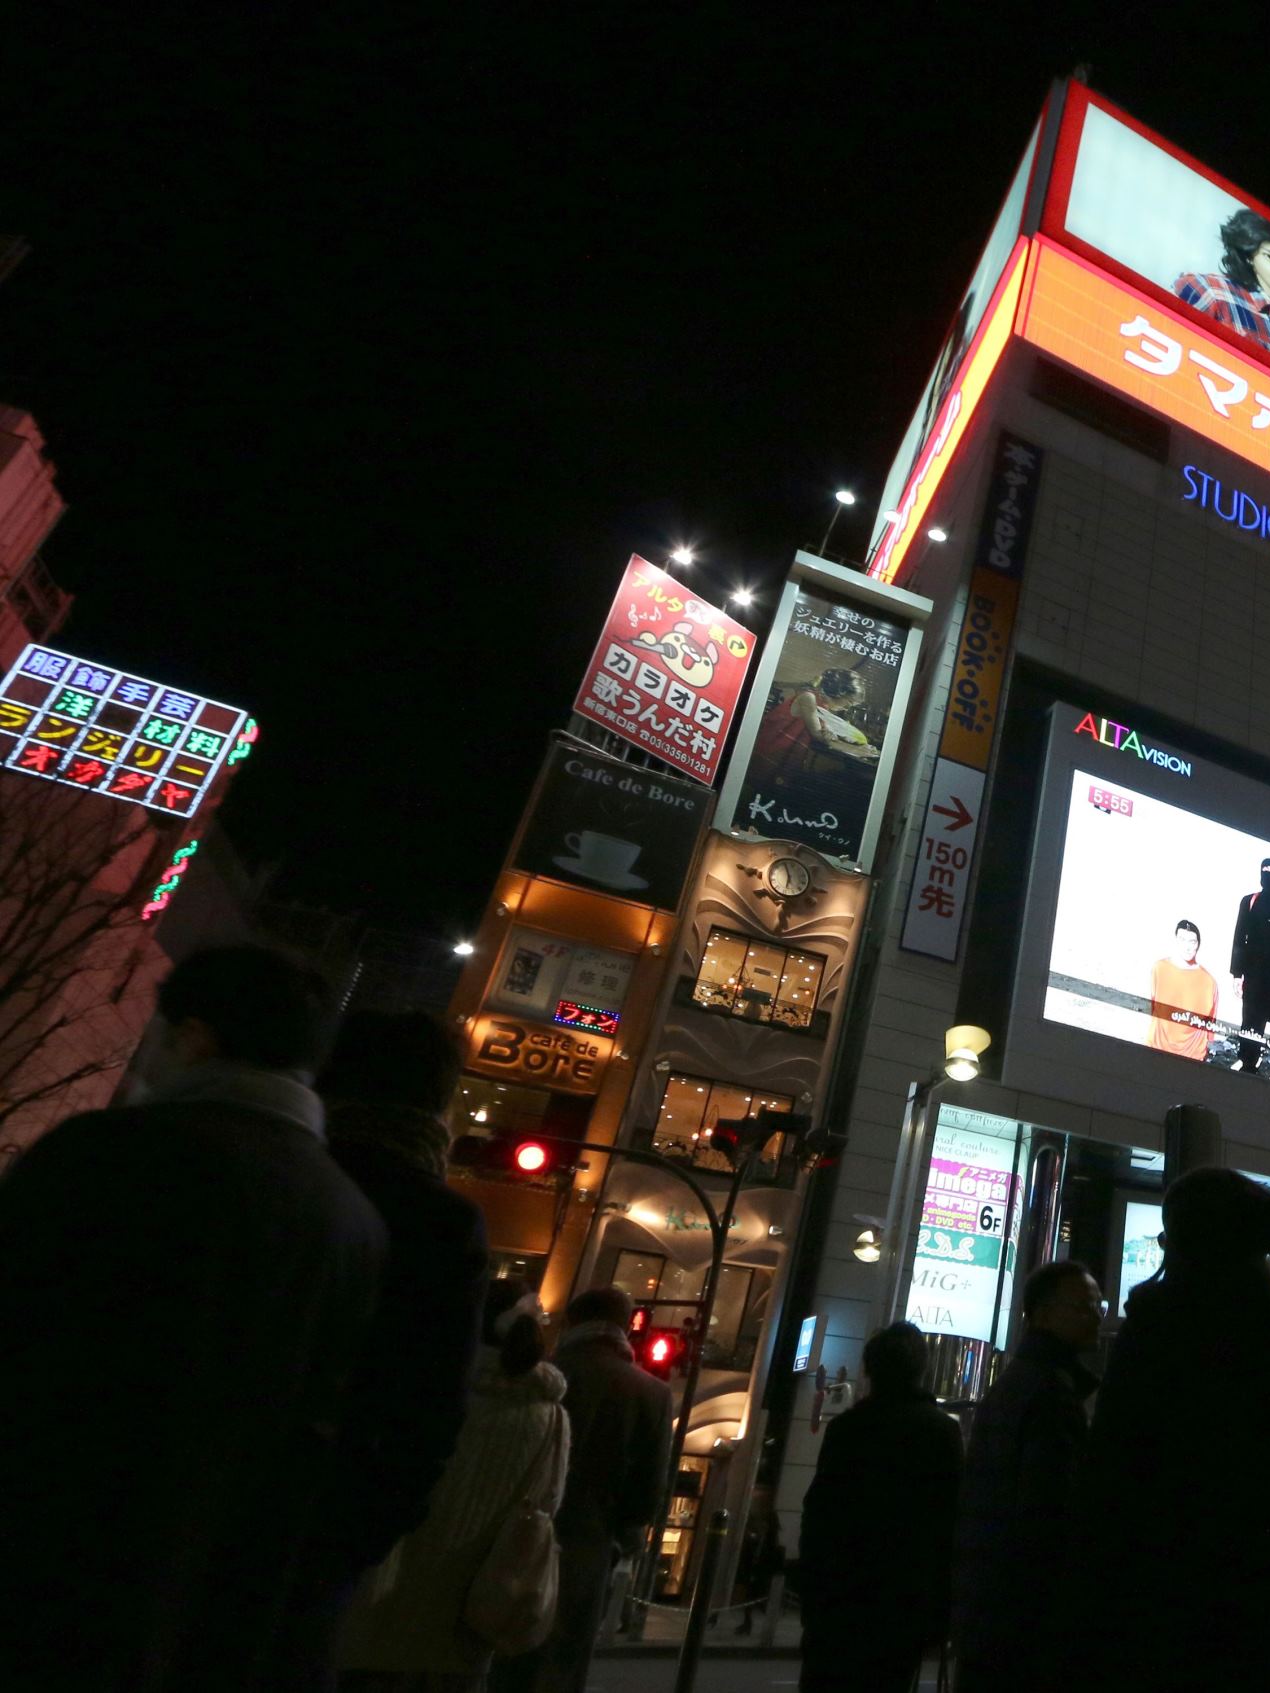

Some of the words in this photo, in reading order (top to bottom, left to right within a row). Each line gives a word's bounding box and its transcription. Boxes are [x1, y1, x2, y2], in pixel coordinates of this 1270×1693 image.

[793, 620, 899, 667] 妖精が棲むお店
[796, 606, 902, 654] ジュエリーを作る
[24, 651, 196, 719] 服飾手芸
[609, 650, 720, 724] カラオケ
[0, 703, 205, 776] ランジェリー
[592, 671, 717, 760] 歌うんだ村
[21, 745, 191, 808] オカダヤ
[564, 760, 613, 786] Cafe
[618, 777, 643, 795] de
[648, 785, 696, 811] Bore
[1093, 787, 1129, 813] 5:55
[577, 1041, 599, 1058] de
[980, 1205, 1002, 1233] 6F
